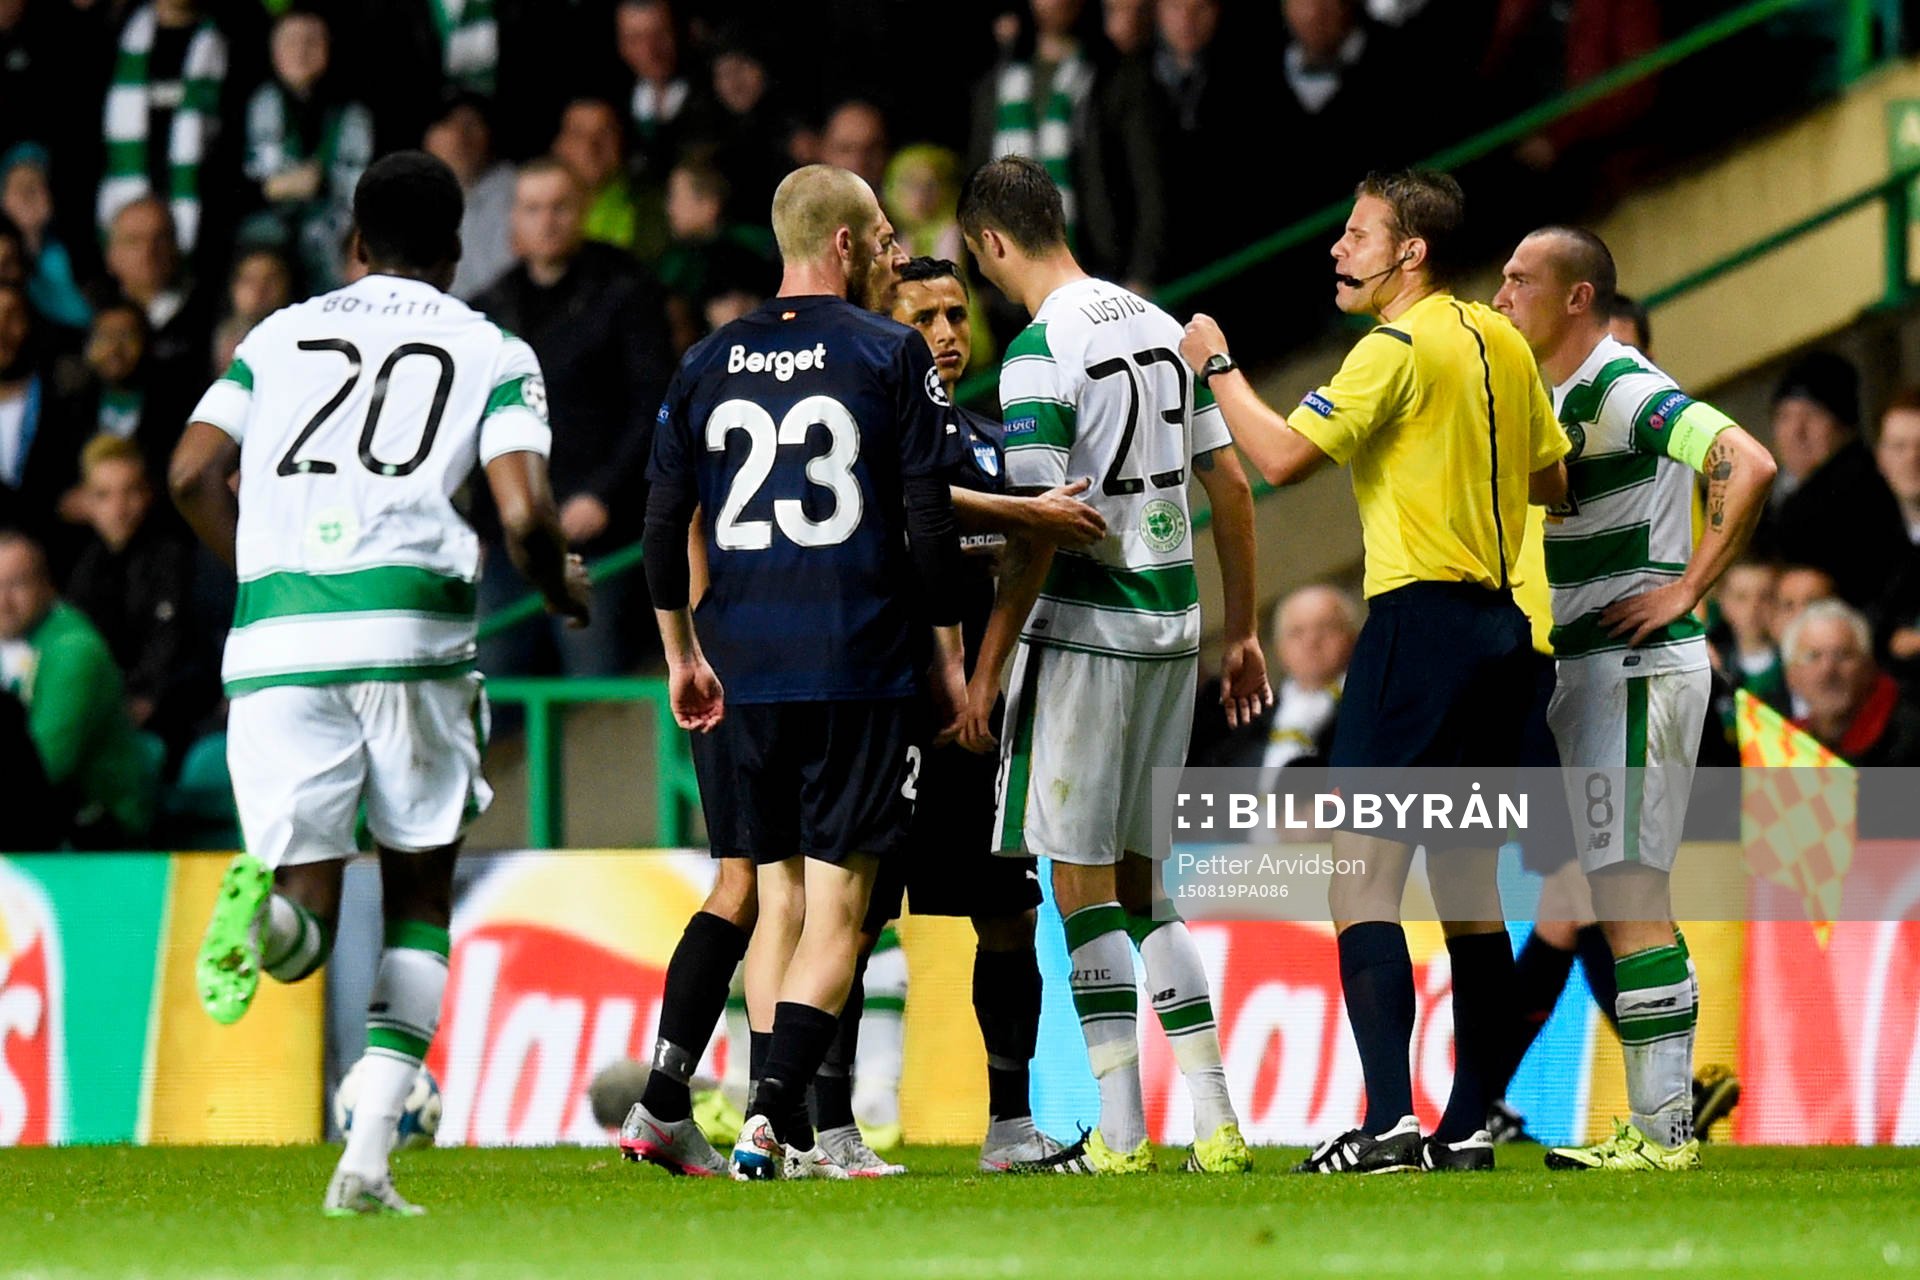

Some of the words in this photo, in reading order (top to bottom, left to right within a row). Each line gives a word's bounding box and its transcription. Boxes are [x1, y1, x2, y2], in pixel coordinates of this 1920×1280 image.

[1079, 295, 1146, 325] LUSTIG
[276, 338, 455, 477] 20
[727, 343, 827, 382] Berget
[1085, 347, 1188, 497] 23
[705, 395, 864, 551] 23
[1585, 772, 1614, 830] 8
